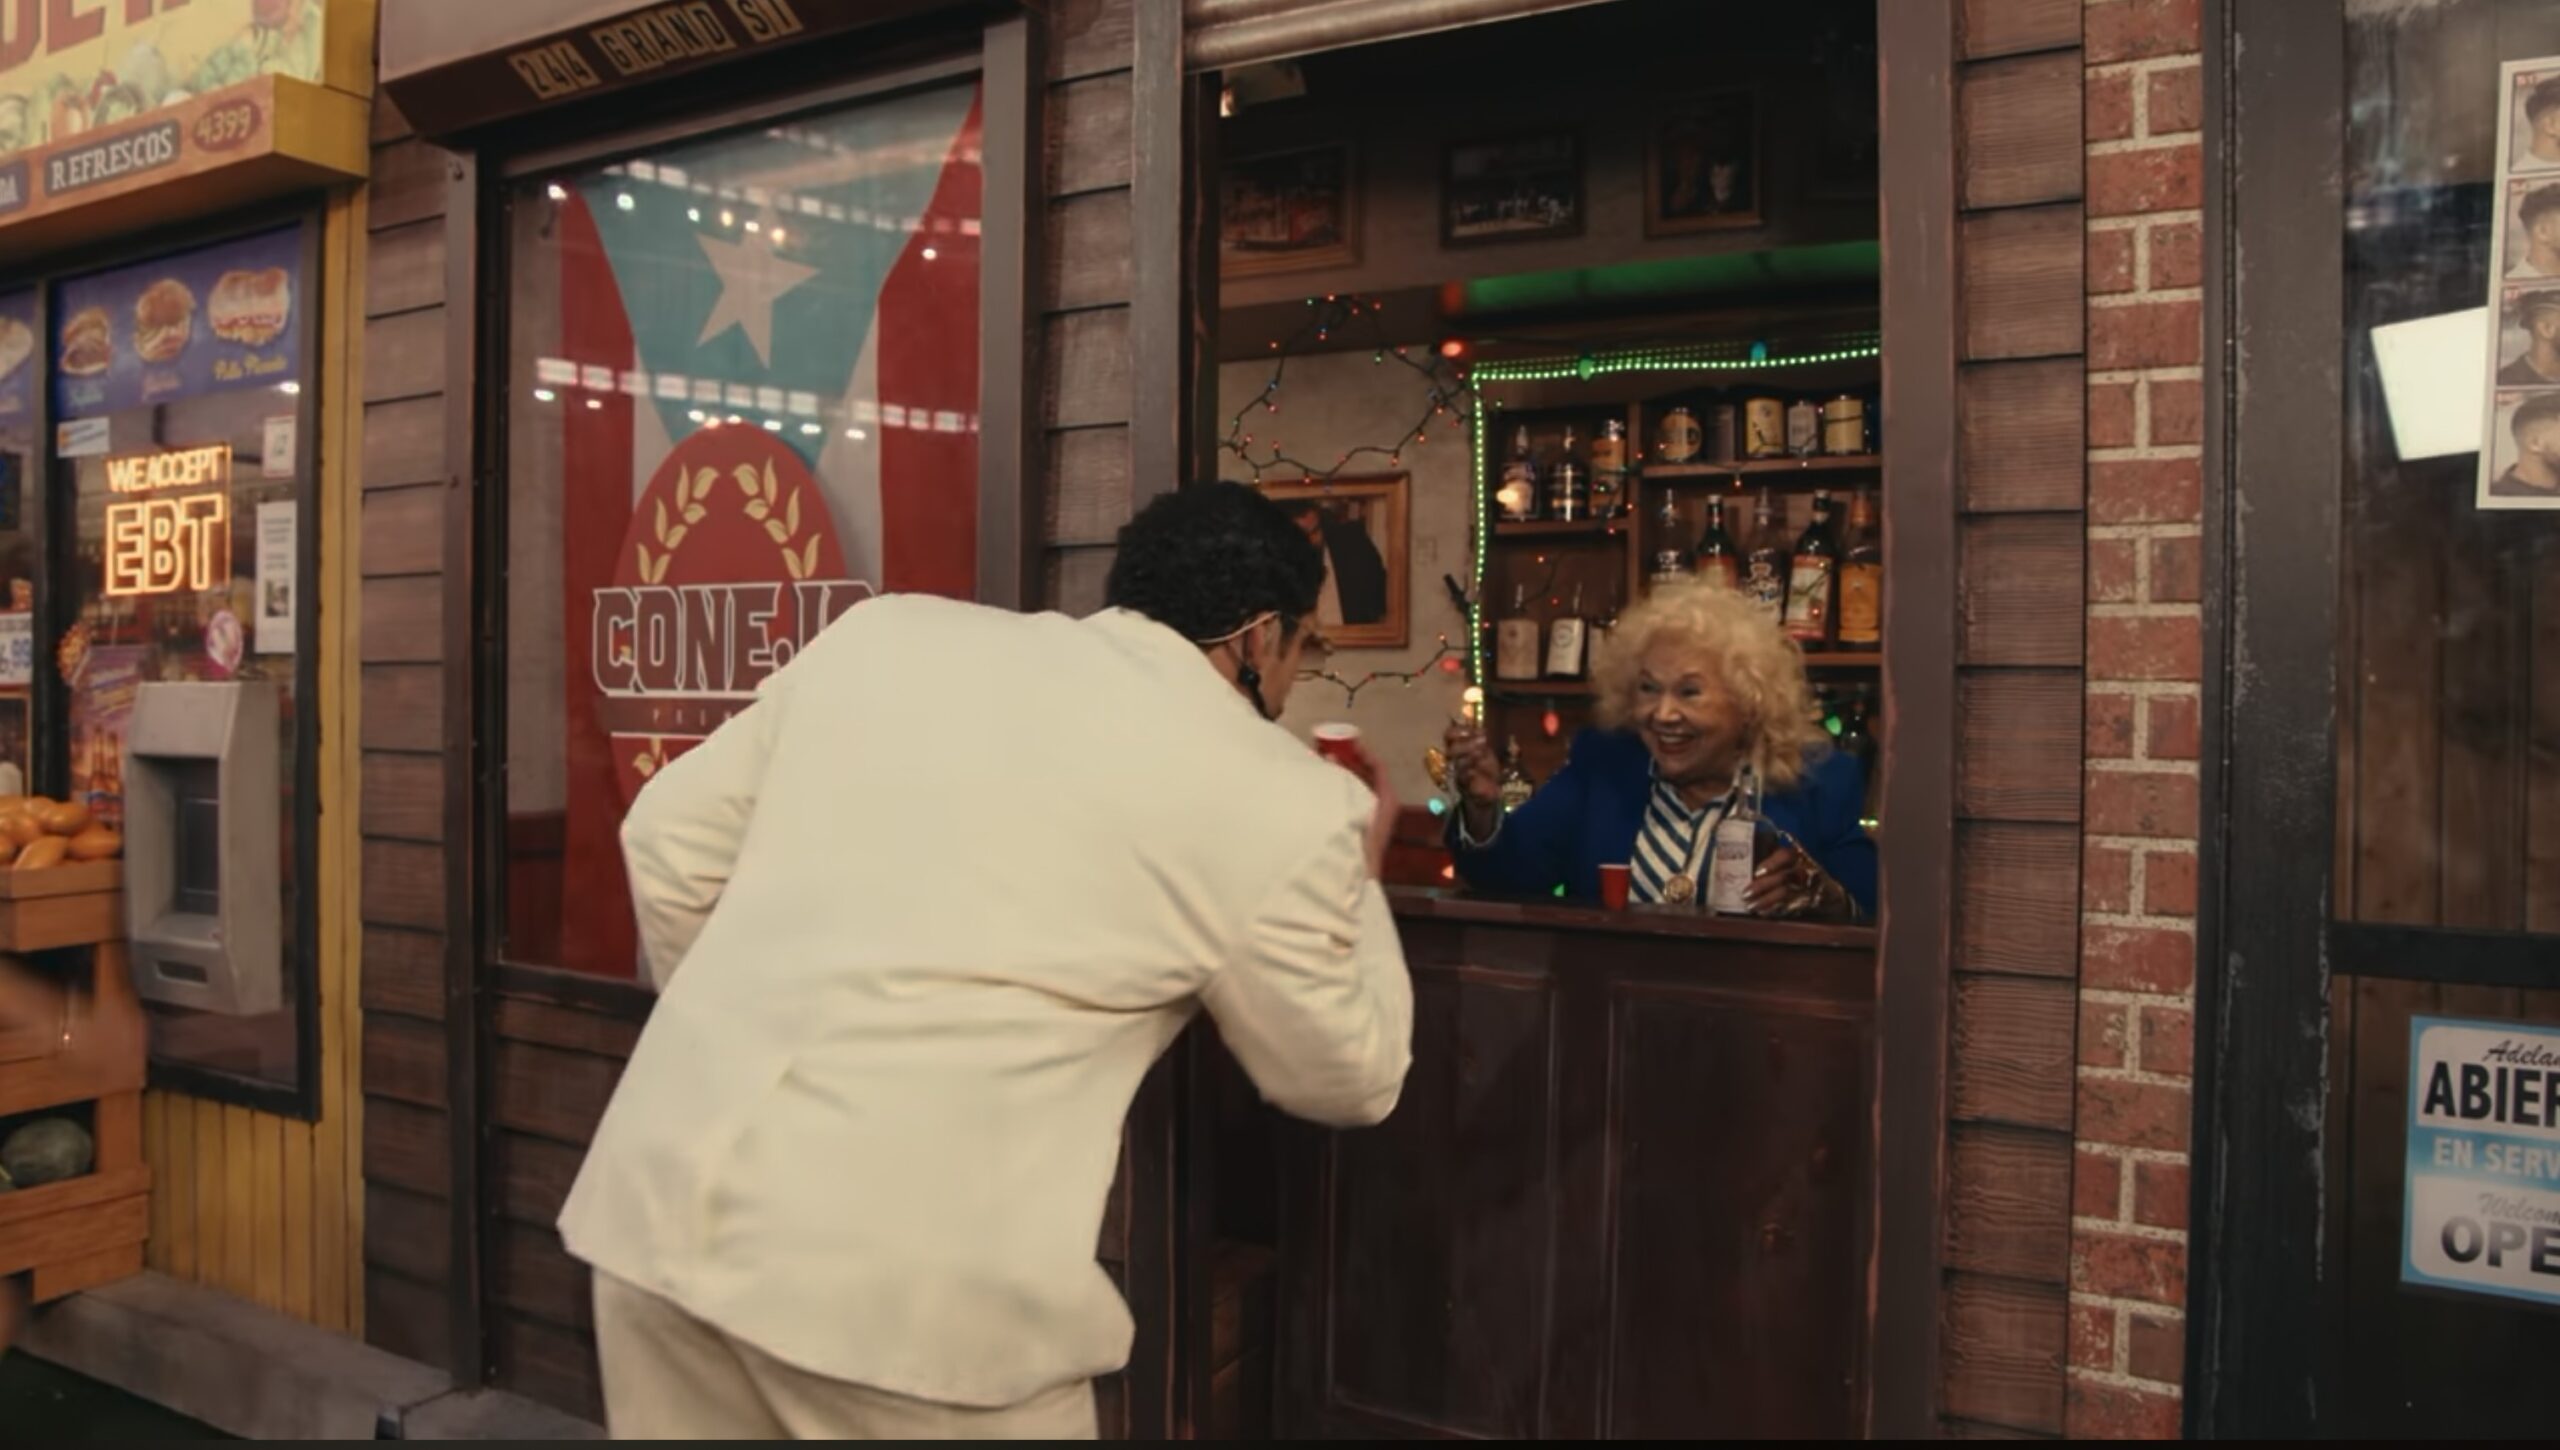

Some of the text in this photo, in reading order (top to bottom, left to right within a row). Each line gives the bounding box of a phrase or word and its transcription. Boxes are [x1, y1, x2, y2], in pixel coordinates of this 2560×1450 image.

[516, 47, 591, 93] 244
[601, 9, 727, 69] GRAND
[197, 106, 251, 145] 4399
[52, 127, 172, 190] REFRESCOS
[107, 446, 224, 493] WE ACCEPT
[106, 493, 223, 596] EBT
[2432, 1136, 2474, 1170] EN
[2441, 1215, 2560, 1276] OPE
